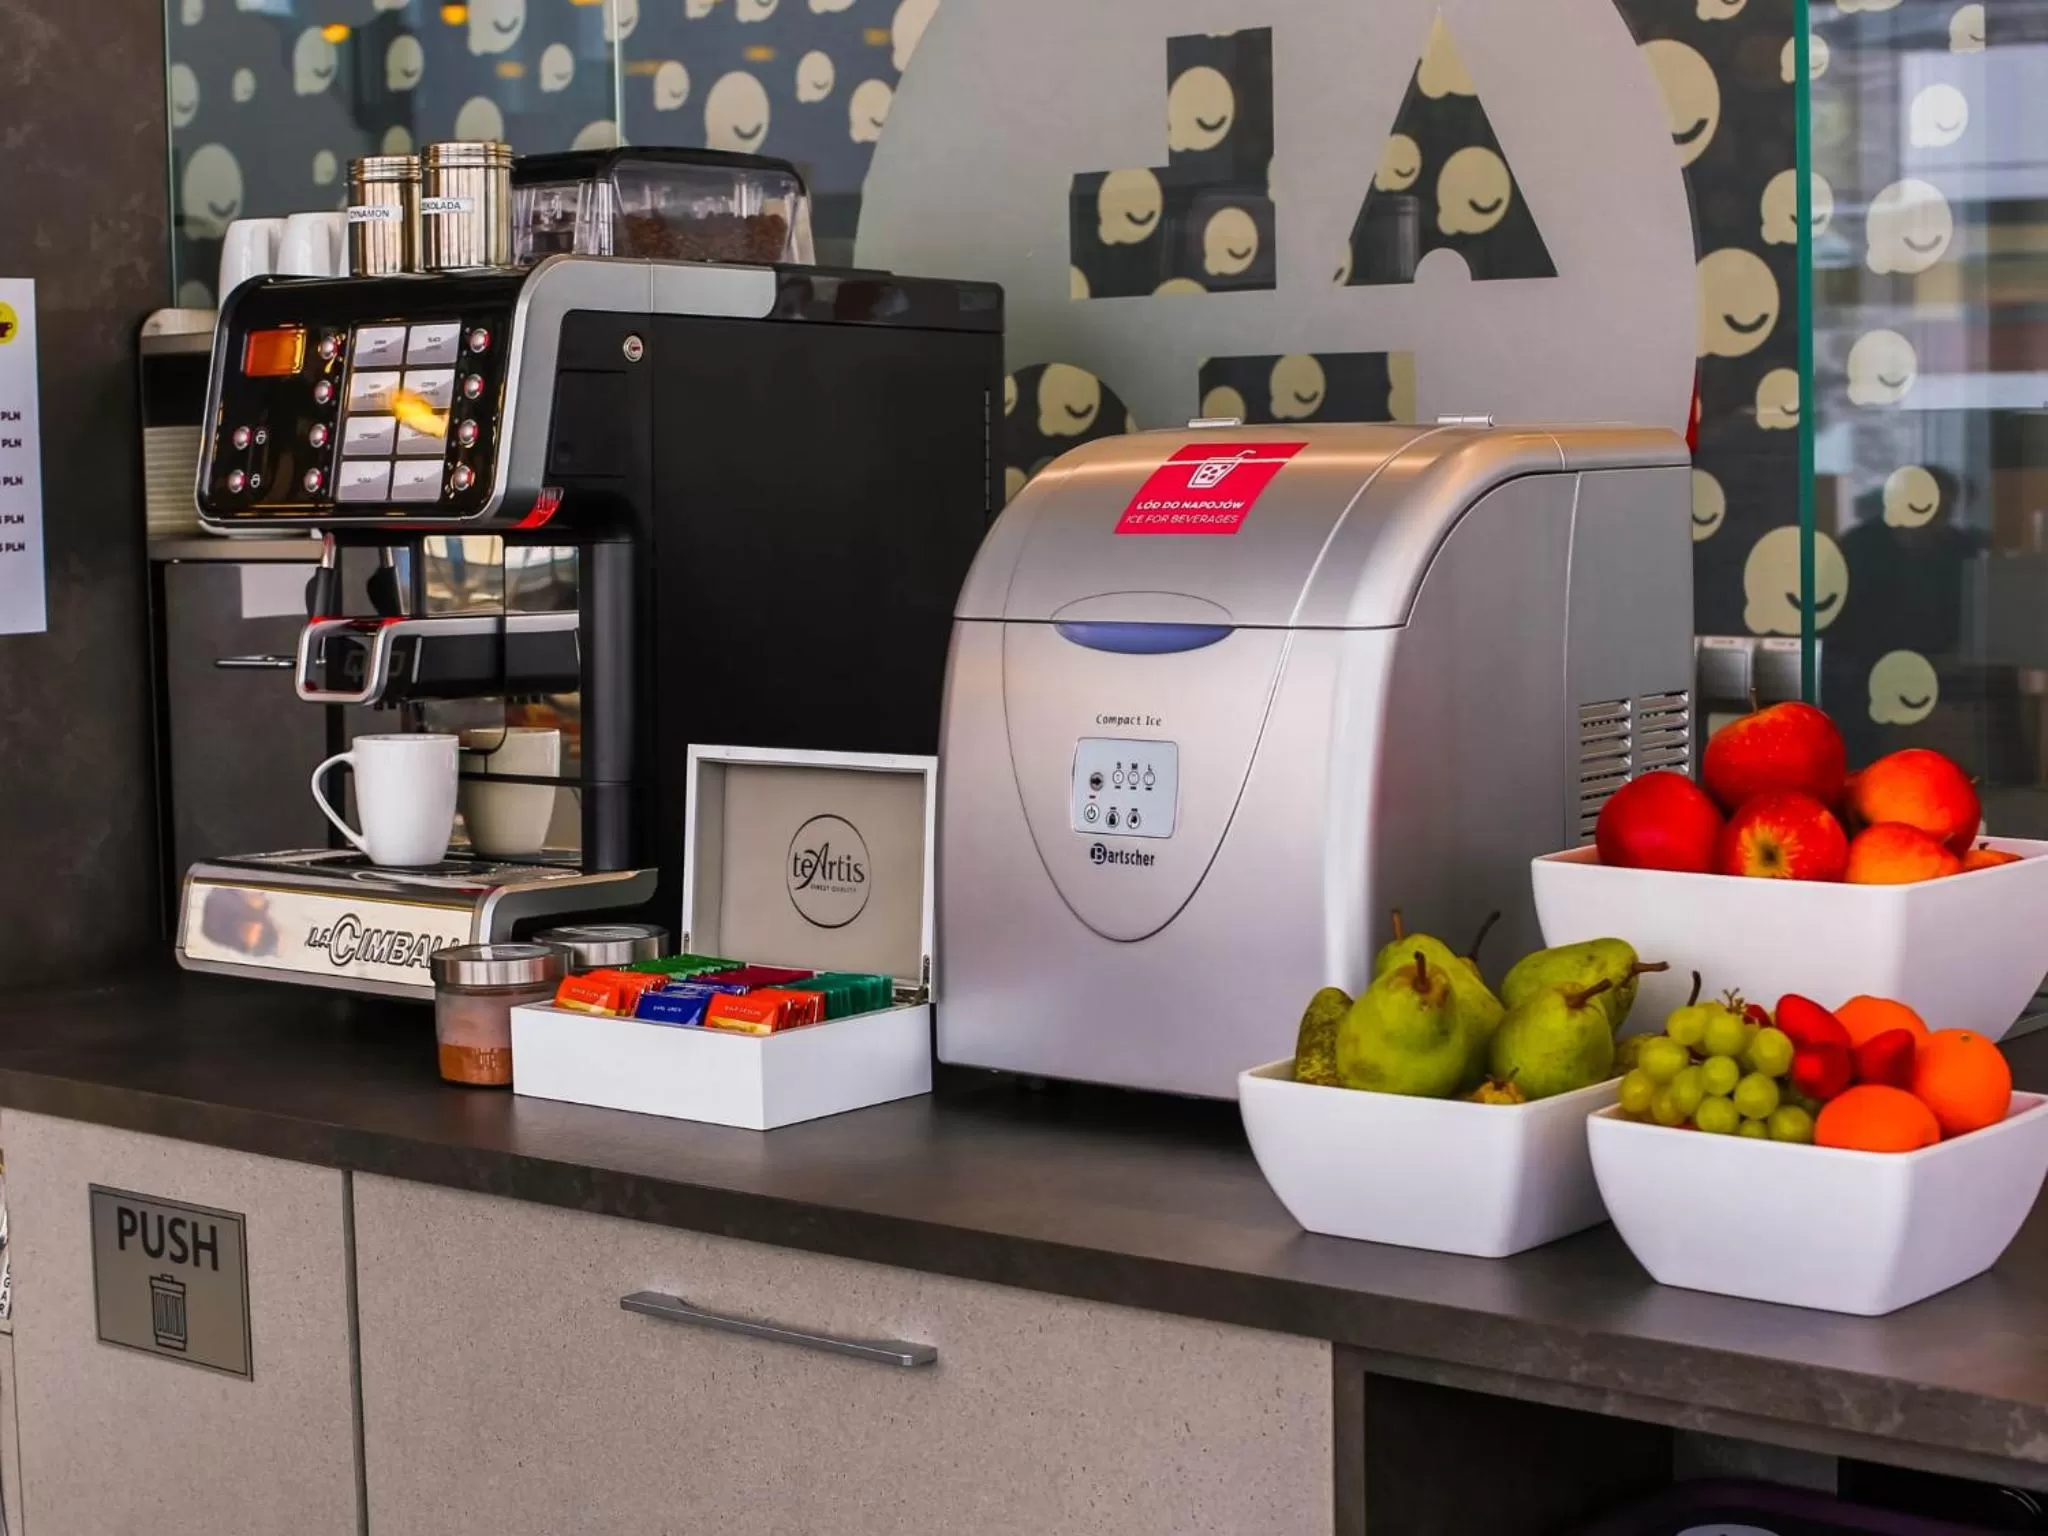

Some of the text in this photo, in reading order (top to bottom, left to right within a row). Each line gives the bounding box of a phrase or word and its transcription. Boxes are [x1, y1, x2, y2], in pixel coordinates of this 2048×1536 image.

[1, 411, 21, 421] PLN
[2, 438, 22, 448] PLN
[3, 476, 23, 486] PLN
[1162, 500, 1179, 509] DO
[1180, 499, 1245, 510] NAPOJÓW
[4, 514, 24, 524] PLN
[1127, 514, 1240, 524] ICE FOR BEVERAGES
[5, 542, 26, 552] PLN
[1095, 713, 1162, 727] Compact Ice
[1090, 842, 1155, 866] Bartscher
[793, 841, 865, 890] teArtis
[306, 926, 333, 950] LA
[116, 1206, 219, 1271] PUSH
